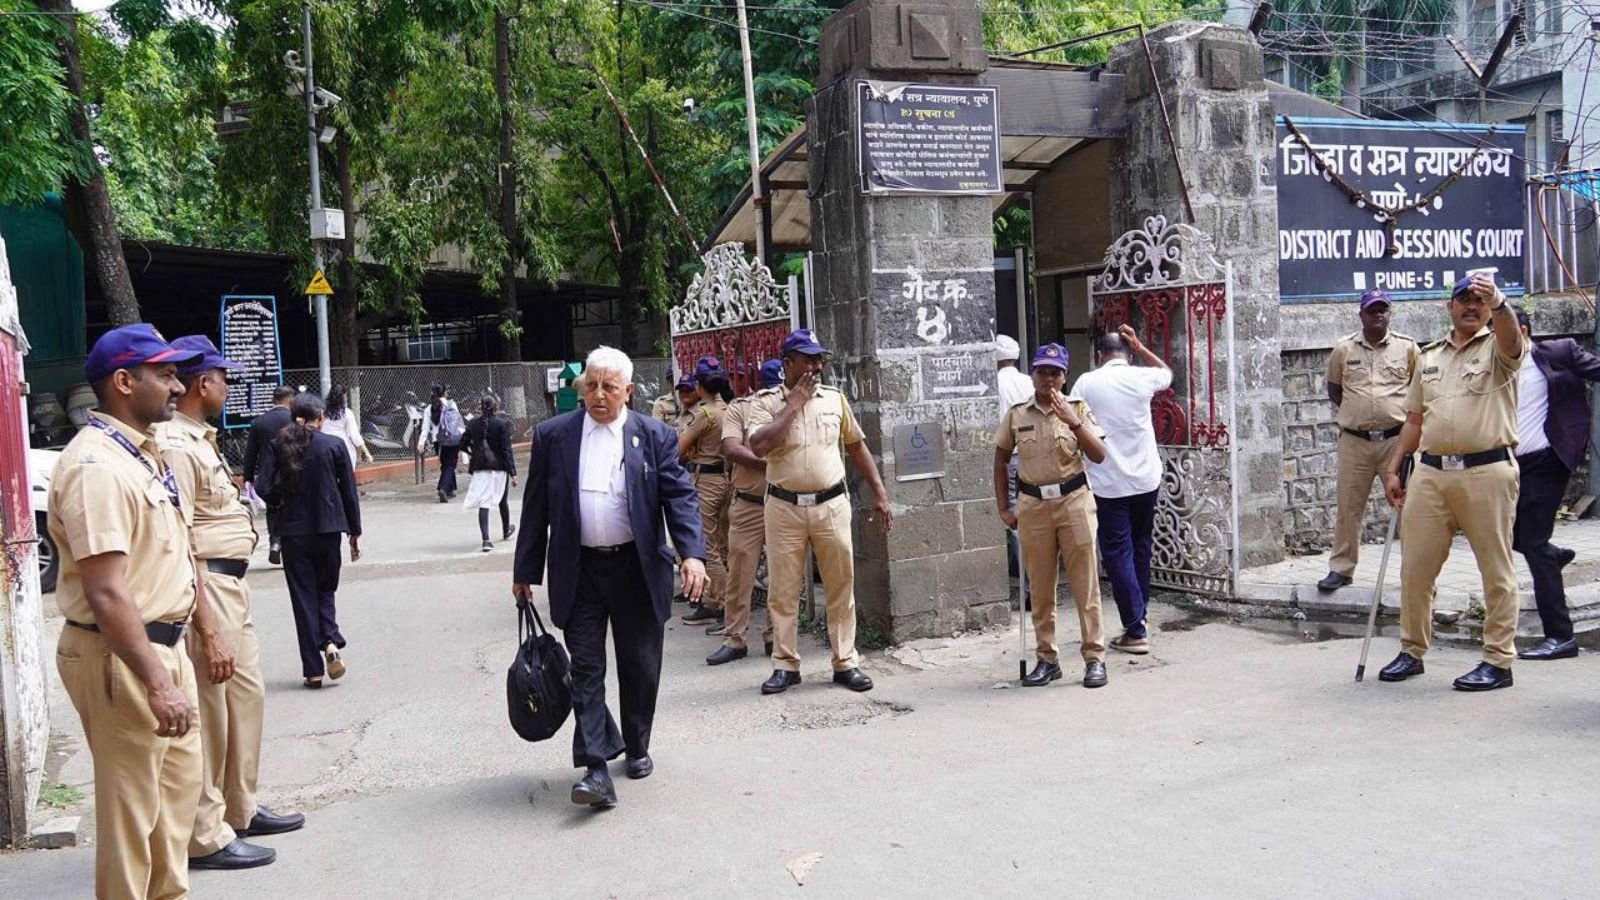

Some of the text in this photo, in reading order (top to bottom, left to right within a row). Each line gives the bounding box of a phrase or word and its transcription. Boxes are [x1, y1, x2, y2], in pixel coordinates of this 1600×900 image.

[906, 93, 923, 103] सत्र
[973, 93, 989, 107] पुणे
[1349, 145, 1365, 175] व
[1367, 145, 1409, 176] सत्र
[1413, 146, 1514, 177] न्यायालय
[1279, 228, 1524, 260] DISTRICT AND SESSIONS COURT
[902, 265, 941, 303] गेट
[1374, 271, 1435, 289] PUNE-5
[916, 305, 947, 344] ४
